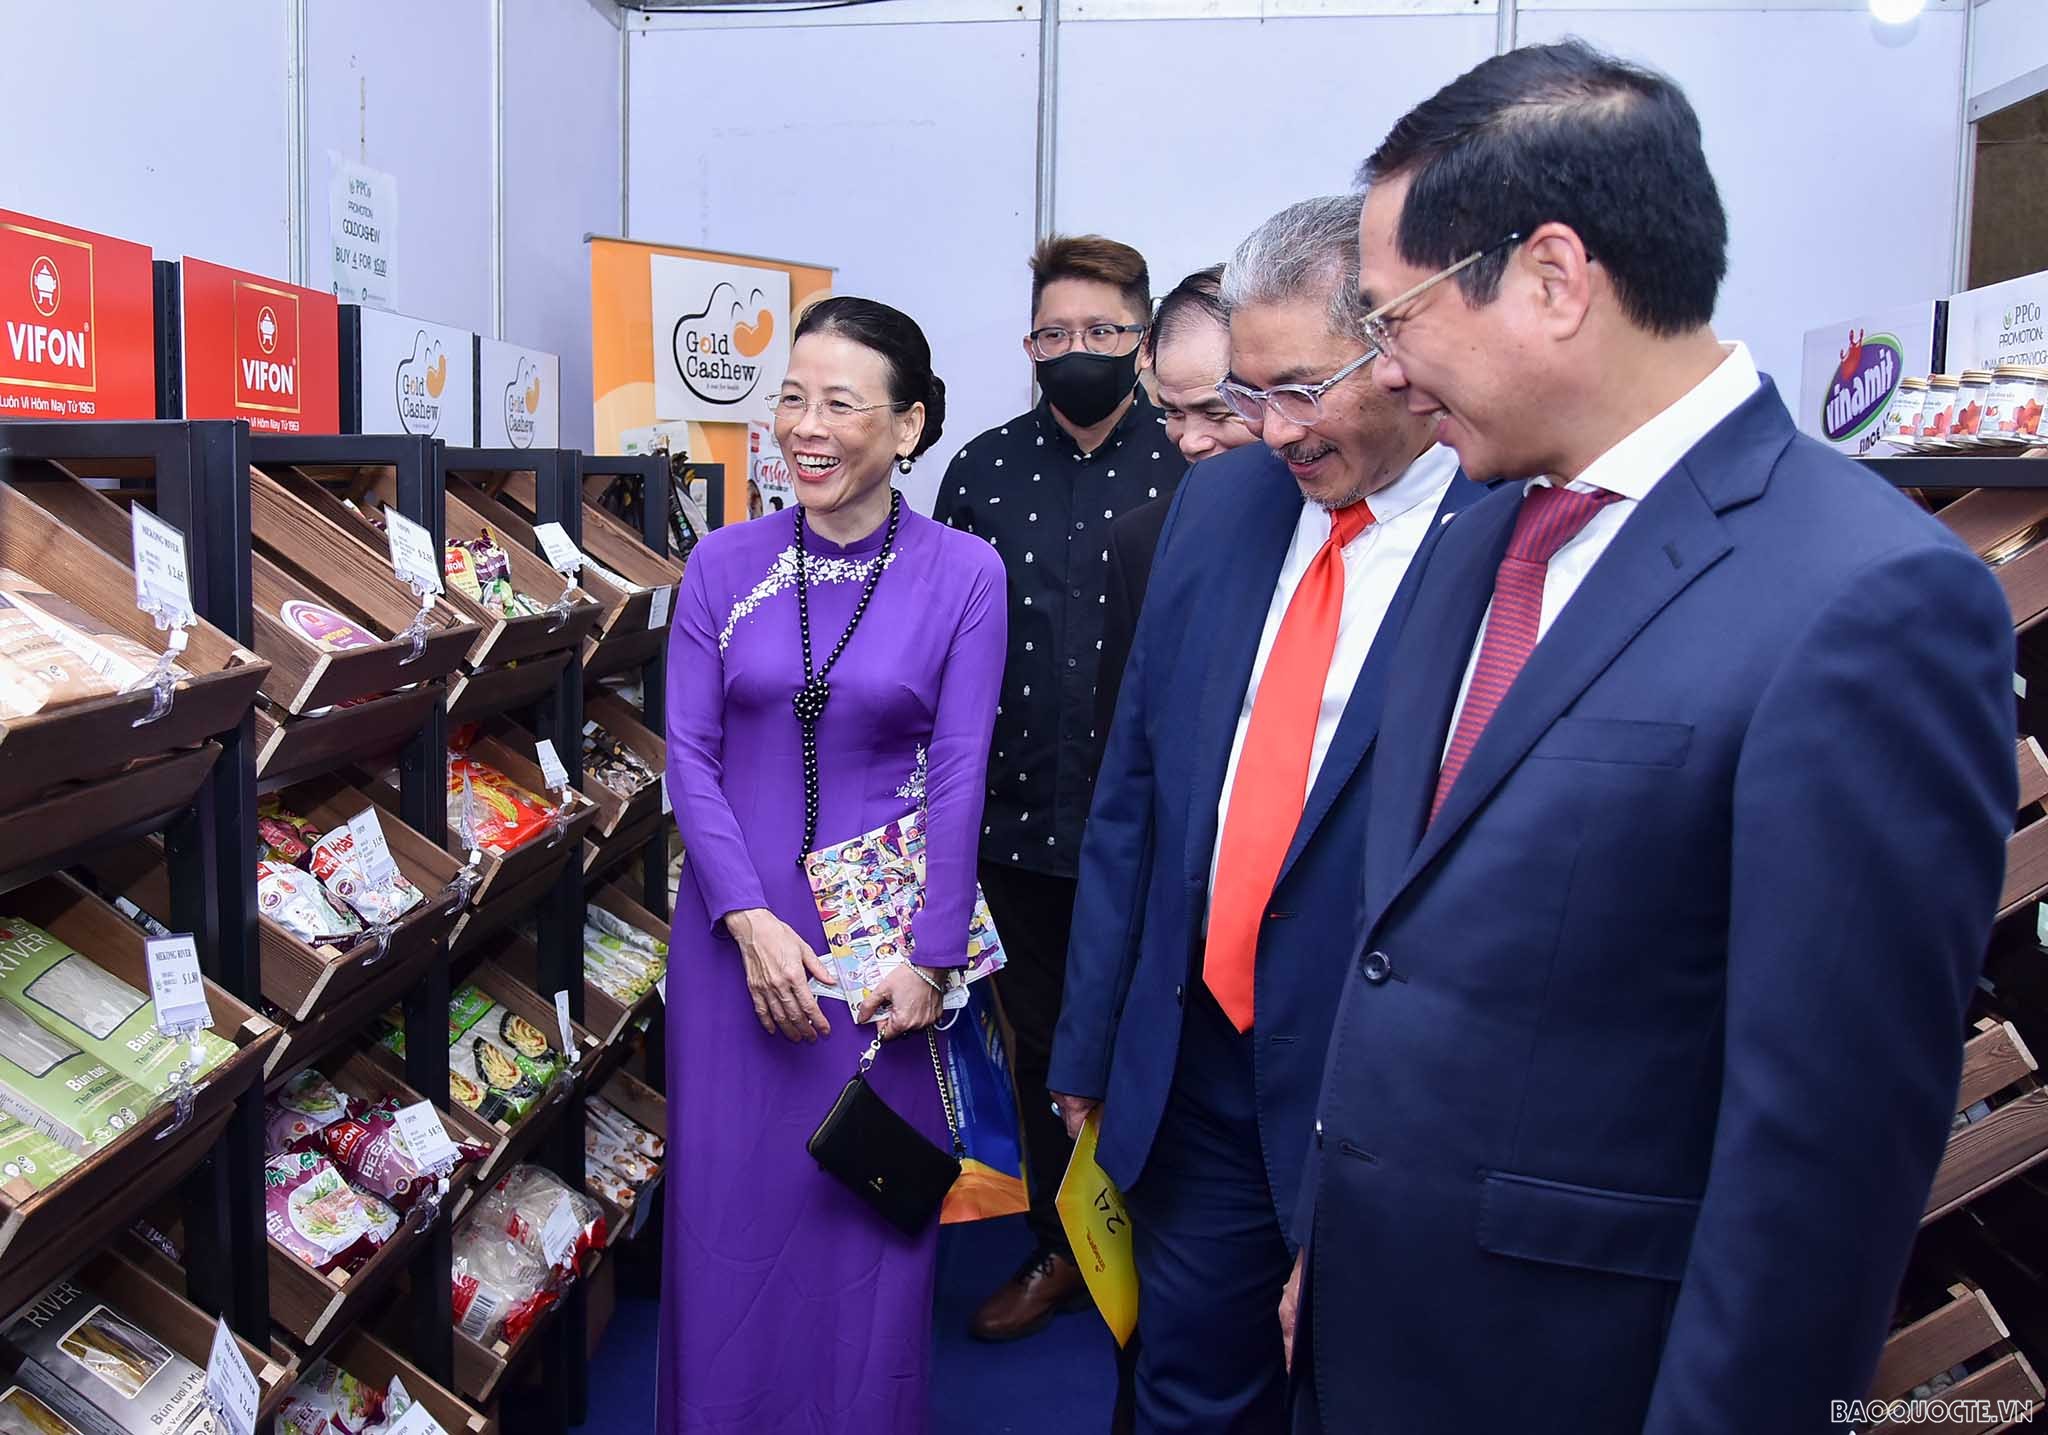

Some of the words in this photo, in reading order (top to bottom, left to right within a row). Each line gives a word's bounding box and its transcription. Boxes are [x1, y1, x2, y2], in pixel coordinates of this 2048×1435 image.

[336, 247, 350, 264] BUY
[359, 253, 371, 270] FOR
[2015, 302, 2041, 325] PPCo
[6, 320, 86, 369] VIFON
[686, 330, 731, 356] Gold
[242, 358, 294, 396] VIFON
[686, 355, 756, 382] Cashew
[402, 374, 425, 397] Gold
[50, 399, 66, 416] Nay
[79, 401, 96, 415] 1963
[402, 396, 439, 421] Cashew
[508, 414, 535, 434] Cashew
[126, 1033, 155, 1053] Bún
[65, 1074, 93, 1092] Bún
[336, 1124, 360, 1156] VIFON
[361, 1135, 386, 1178] BEEF
[24, 1282, 83, 1328] RIVER
